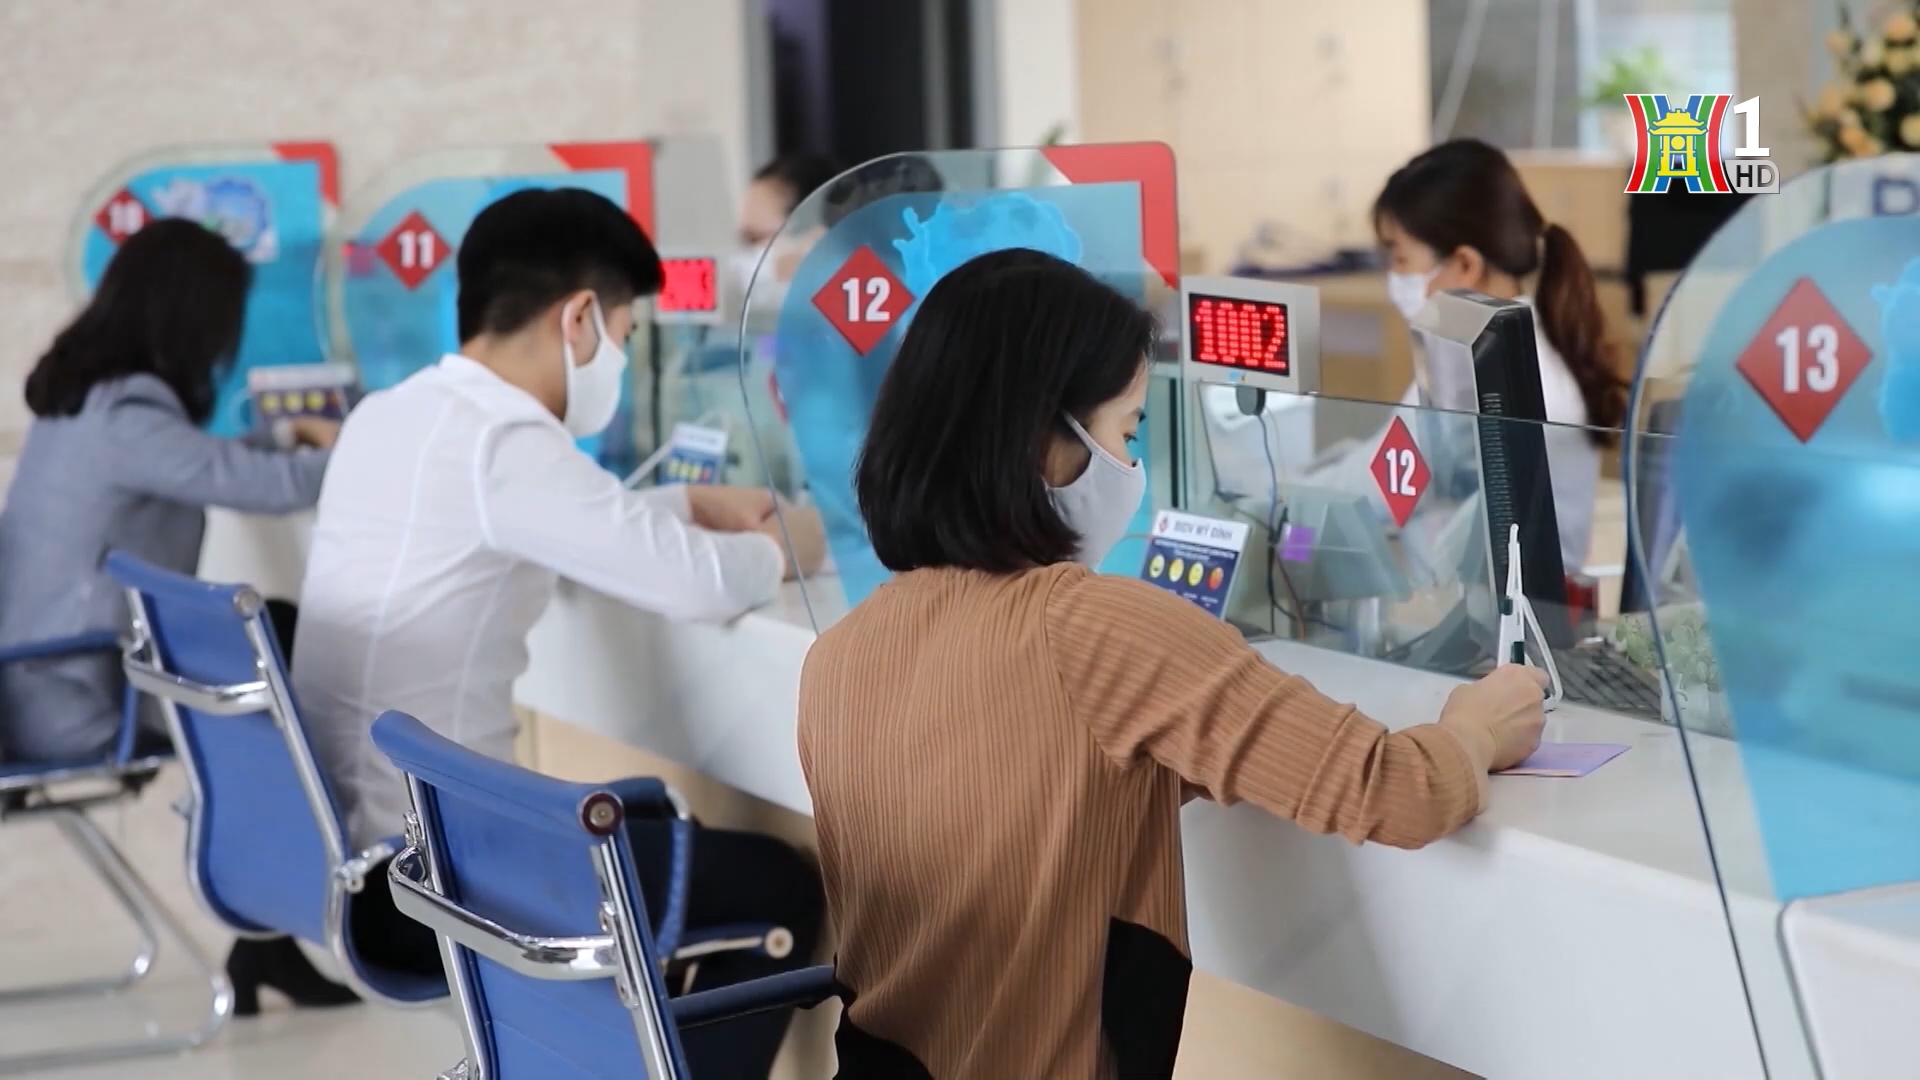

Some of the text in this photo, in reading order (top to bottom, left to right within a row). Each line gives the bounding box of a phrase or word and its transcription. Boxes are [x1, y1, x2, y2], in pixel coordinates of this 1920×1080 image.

[397, 230, 435, 270] 11
[842, 276, 892, 323] 12
[1195, 300, 1287, 369] 1002
[1775, 323, 1841, 394] 13
[1385, 447, 1417, 497] 12
